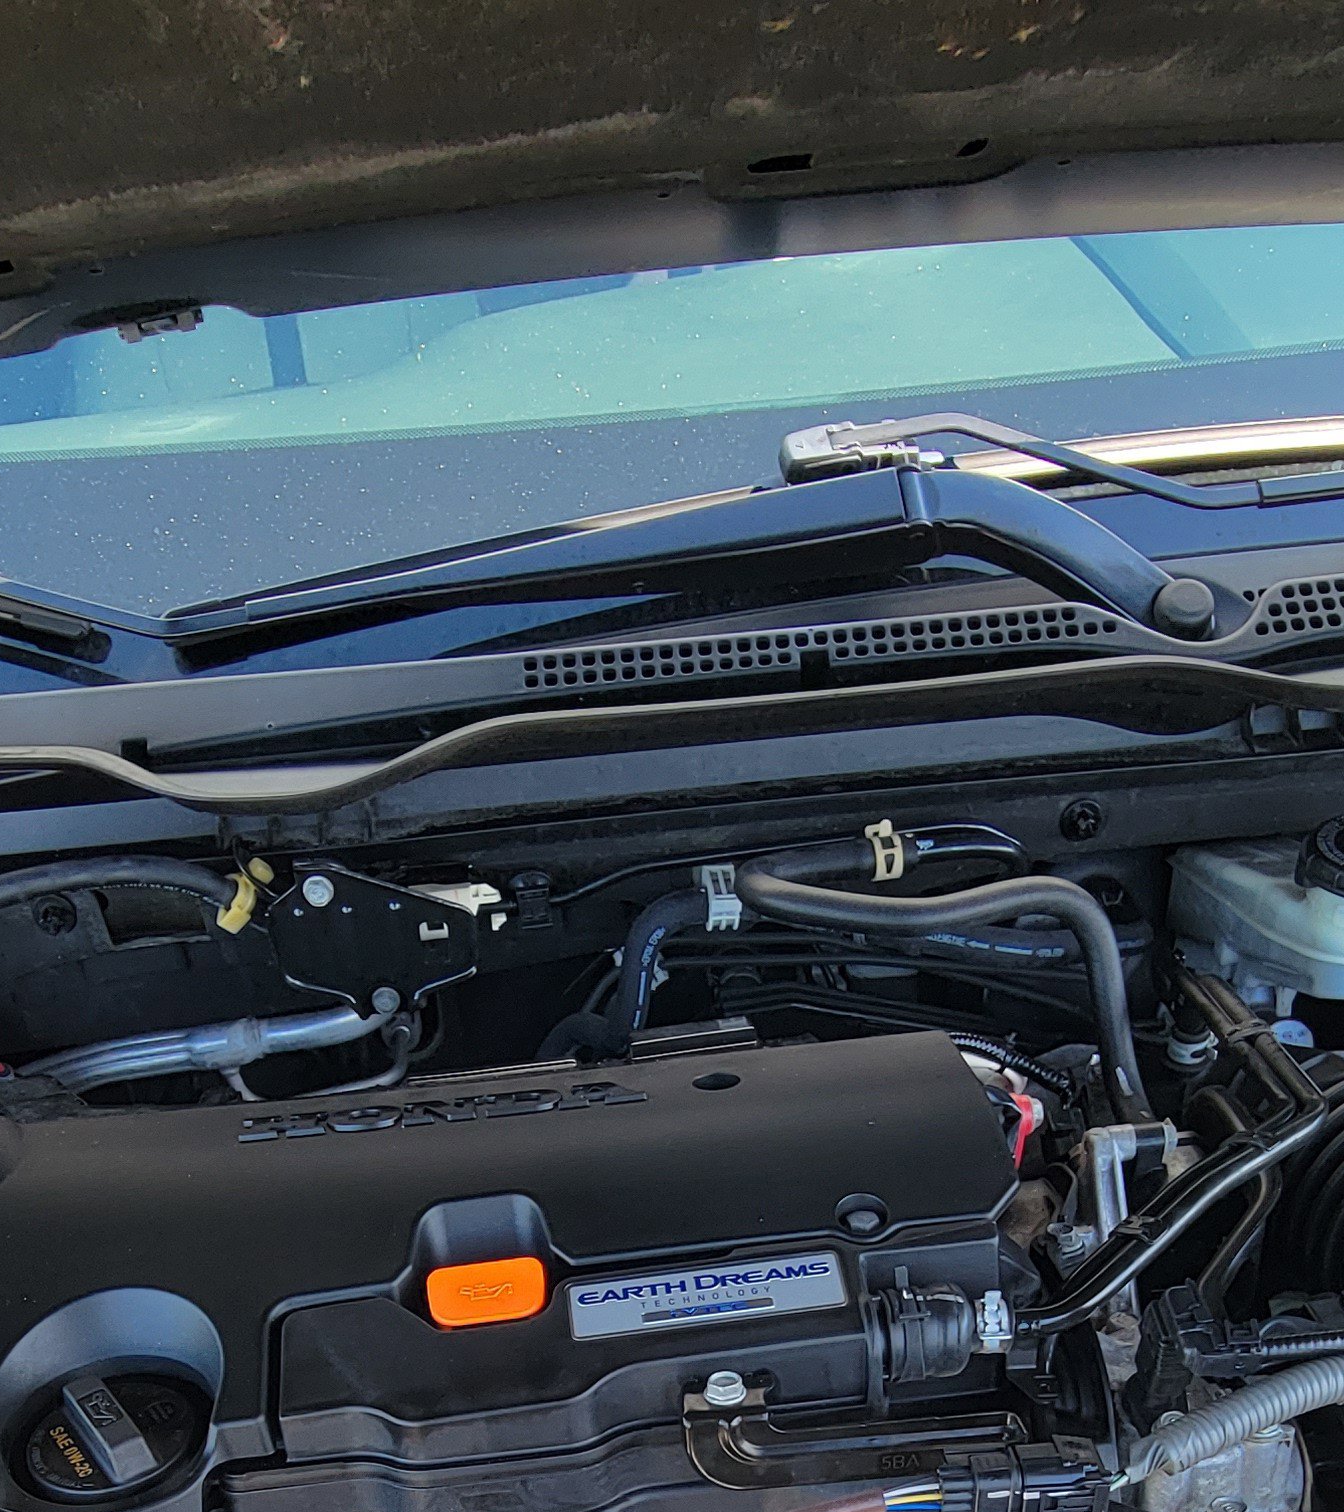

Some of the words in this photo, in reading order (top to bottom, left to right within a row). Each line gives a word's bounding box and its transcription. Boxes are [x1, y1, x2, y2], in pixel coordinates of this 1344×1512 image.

[238, 1081, 648, 1143] HONDA
[577, 1279, 687, 1306] EARTH
[693, 1261, 831, 1291] DREAMS
[641, 1286, 771, 1309] TECHNOLOGY
[49, 1425, 70, 1449] SAE
[63, 1446, 95, 1478] 0W-20
